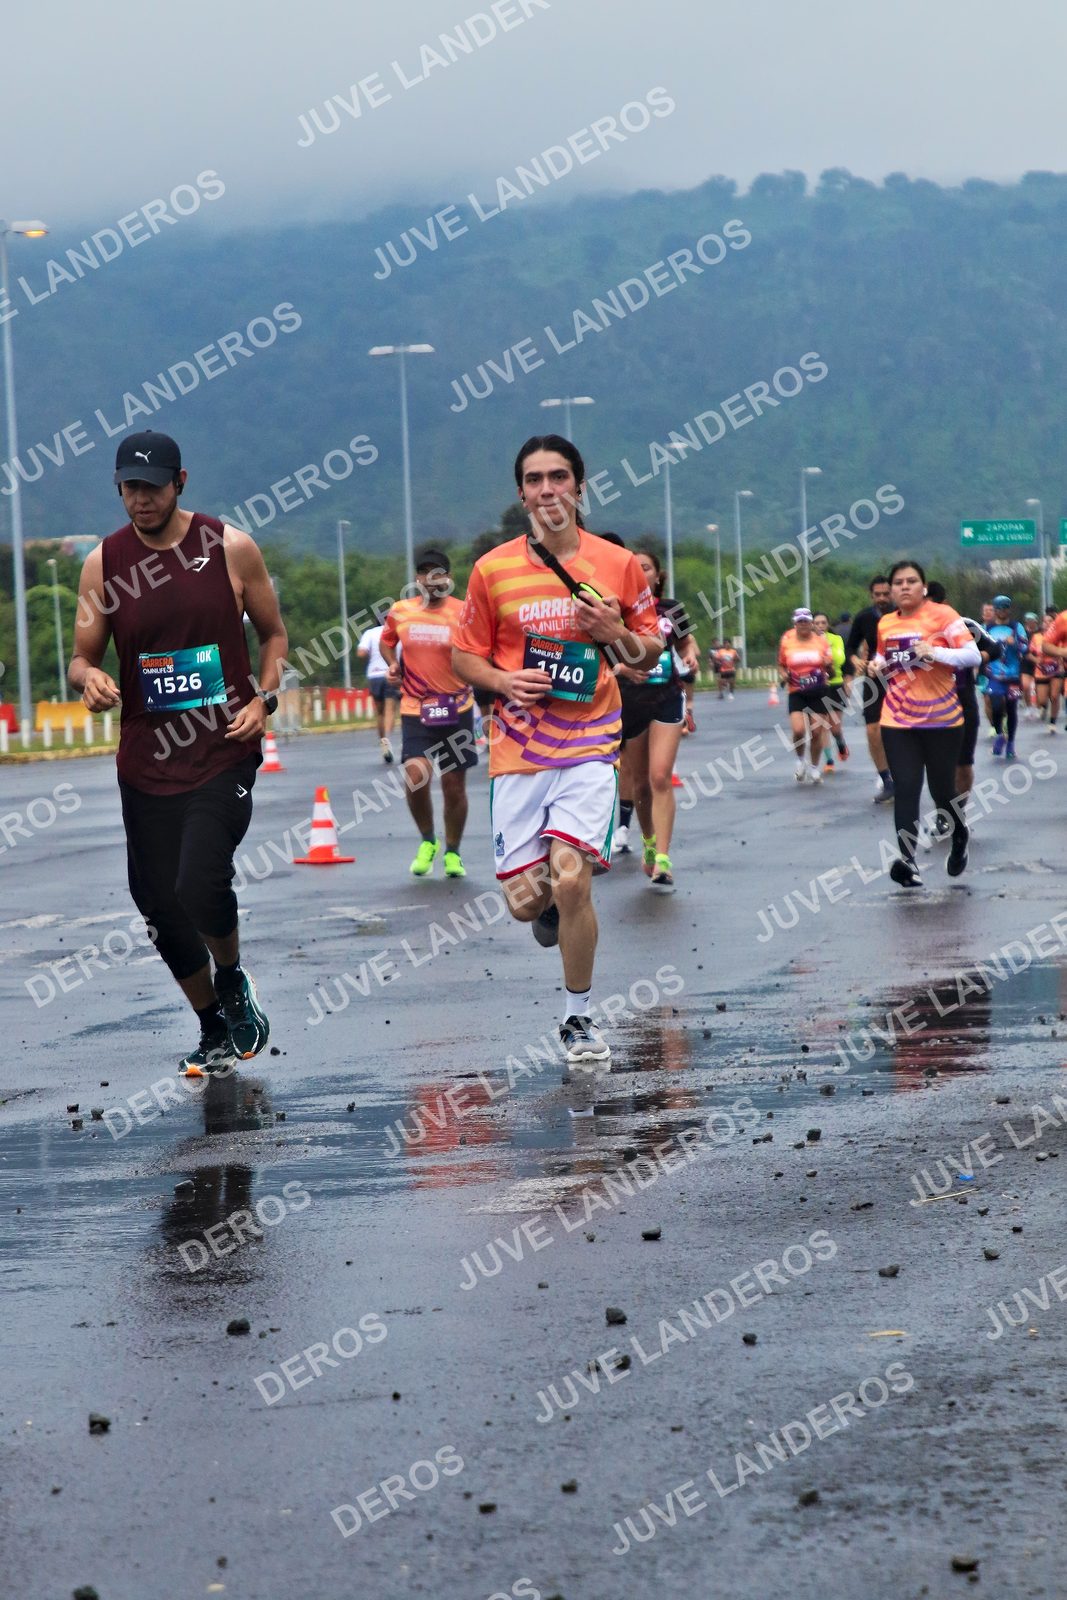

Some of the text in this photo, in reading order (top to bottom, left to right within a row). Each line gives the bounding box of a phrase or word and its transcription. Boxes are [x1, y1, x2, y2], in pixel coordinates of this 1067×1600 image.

[530, 638, 564, 652] CARRERA
[142, 656, 174, 668] CARRERA
[196, 649, 212, 664] 10K
[892, 652, 910, 661] 575
[538, 660, 584, 684] 1140
[153, 672, 202, 694] 1526
[428, 707, 448, 716] 286
